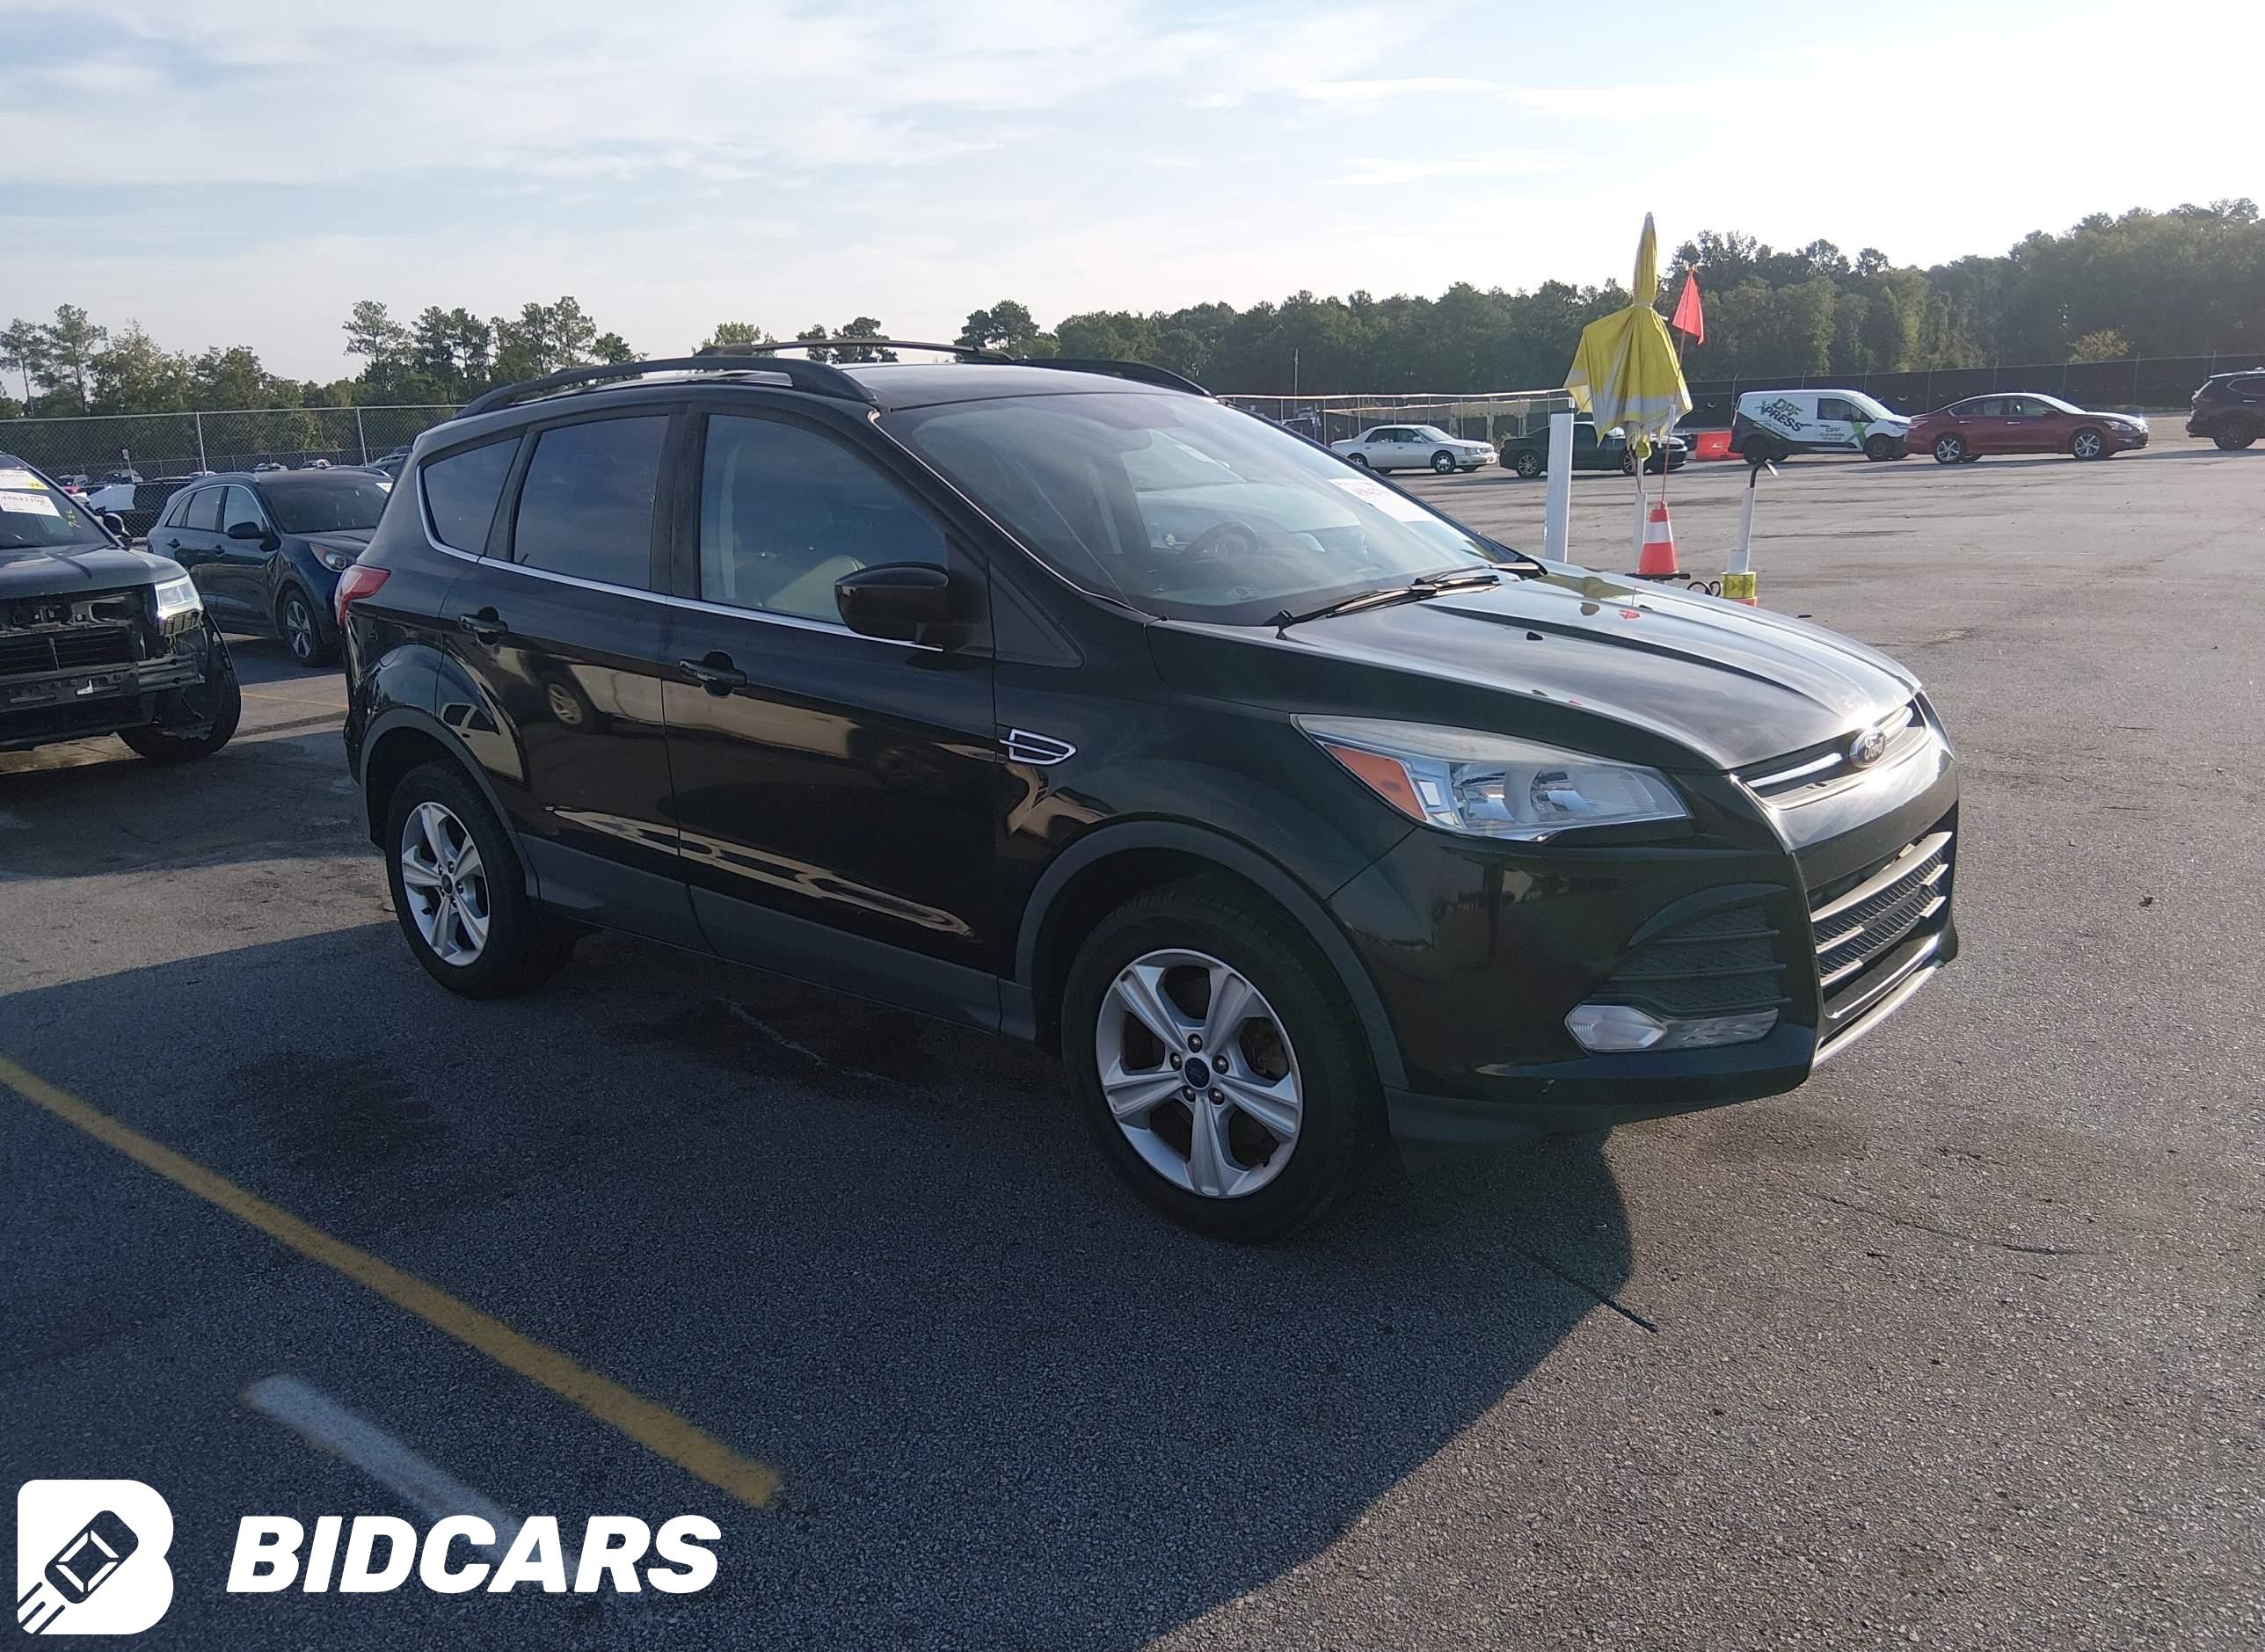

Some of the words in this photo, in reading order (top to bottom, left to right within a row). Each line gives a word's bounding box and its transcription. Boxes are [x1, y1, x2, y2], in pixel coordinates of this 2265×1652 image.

[1755, 400, 1801, 432] XPRESS
[1773, 398, 1803, 416] DPF
[1864, 735, 1883, 761] Ford
